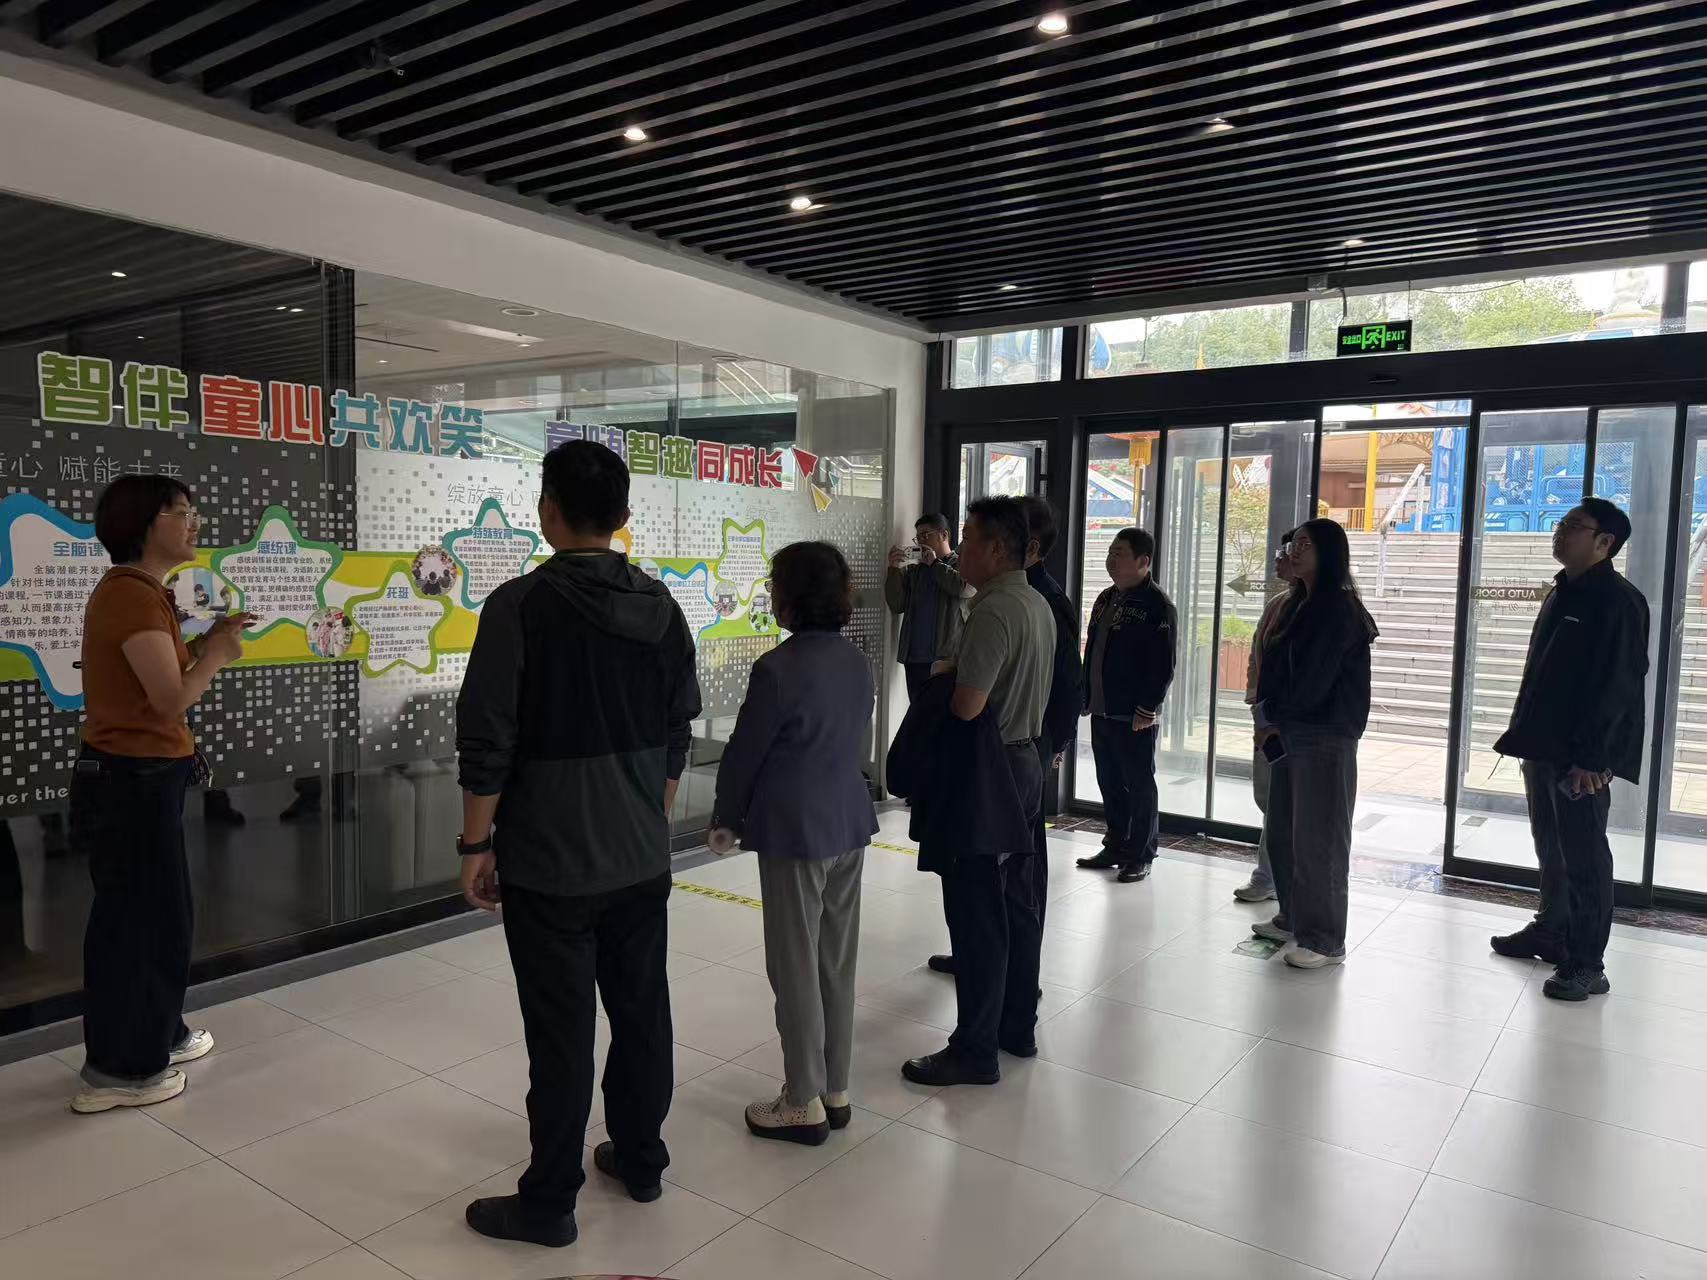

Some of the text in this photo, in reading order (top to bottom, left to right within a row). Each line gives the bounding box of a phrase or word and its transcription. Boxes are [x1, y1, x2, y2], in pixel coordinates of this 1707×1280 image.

[1386, 330, 1406, 341] EXIT
[37, 351, 484, 459] 智伴童心共欢笑
[0, 452, 43, 478] 心
[53, 541, 104, 557] 全脑课
[257, 541, 297, 555] 感统课
[0, 786, 69, 806] er the
